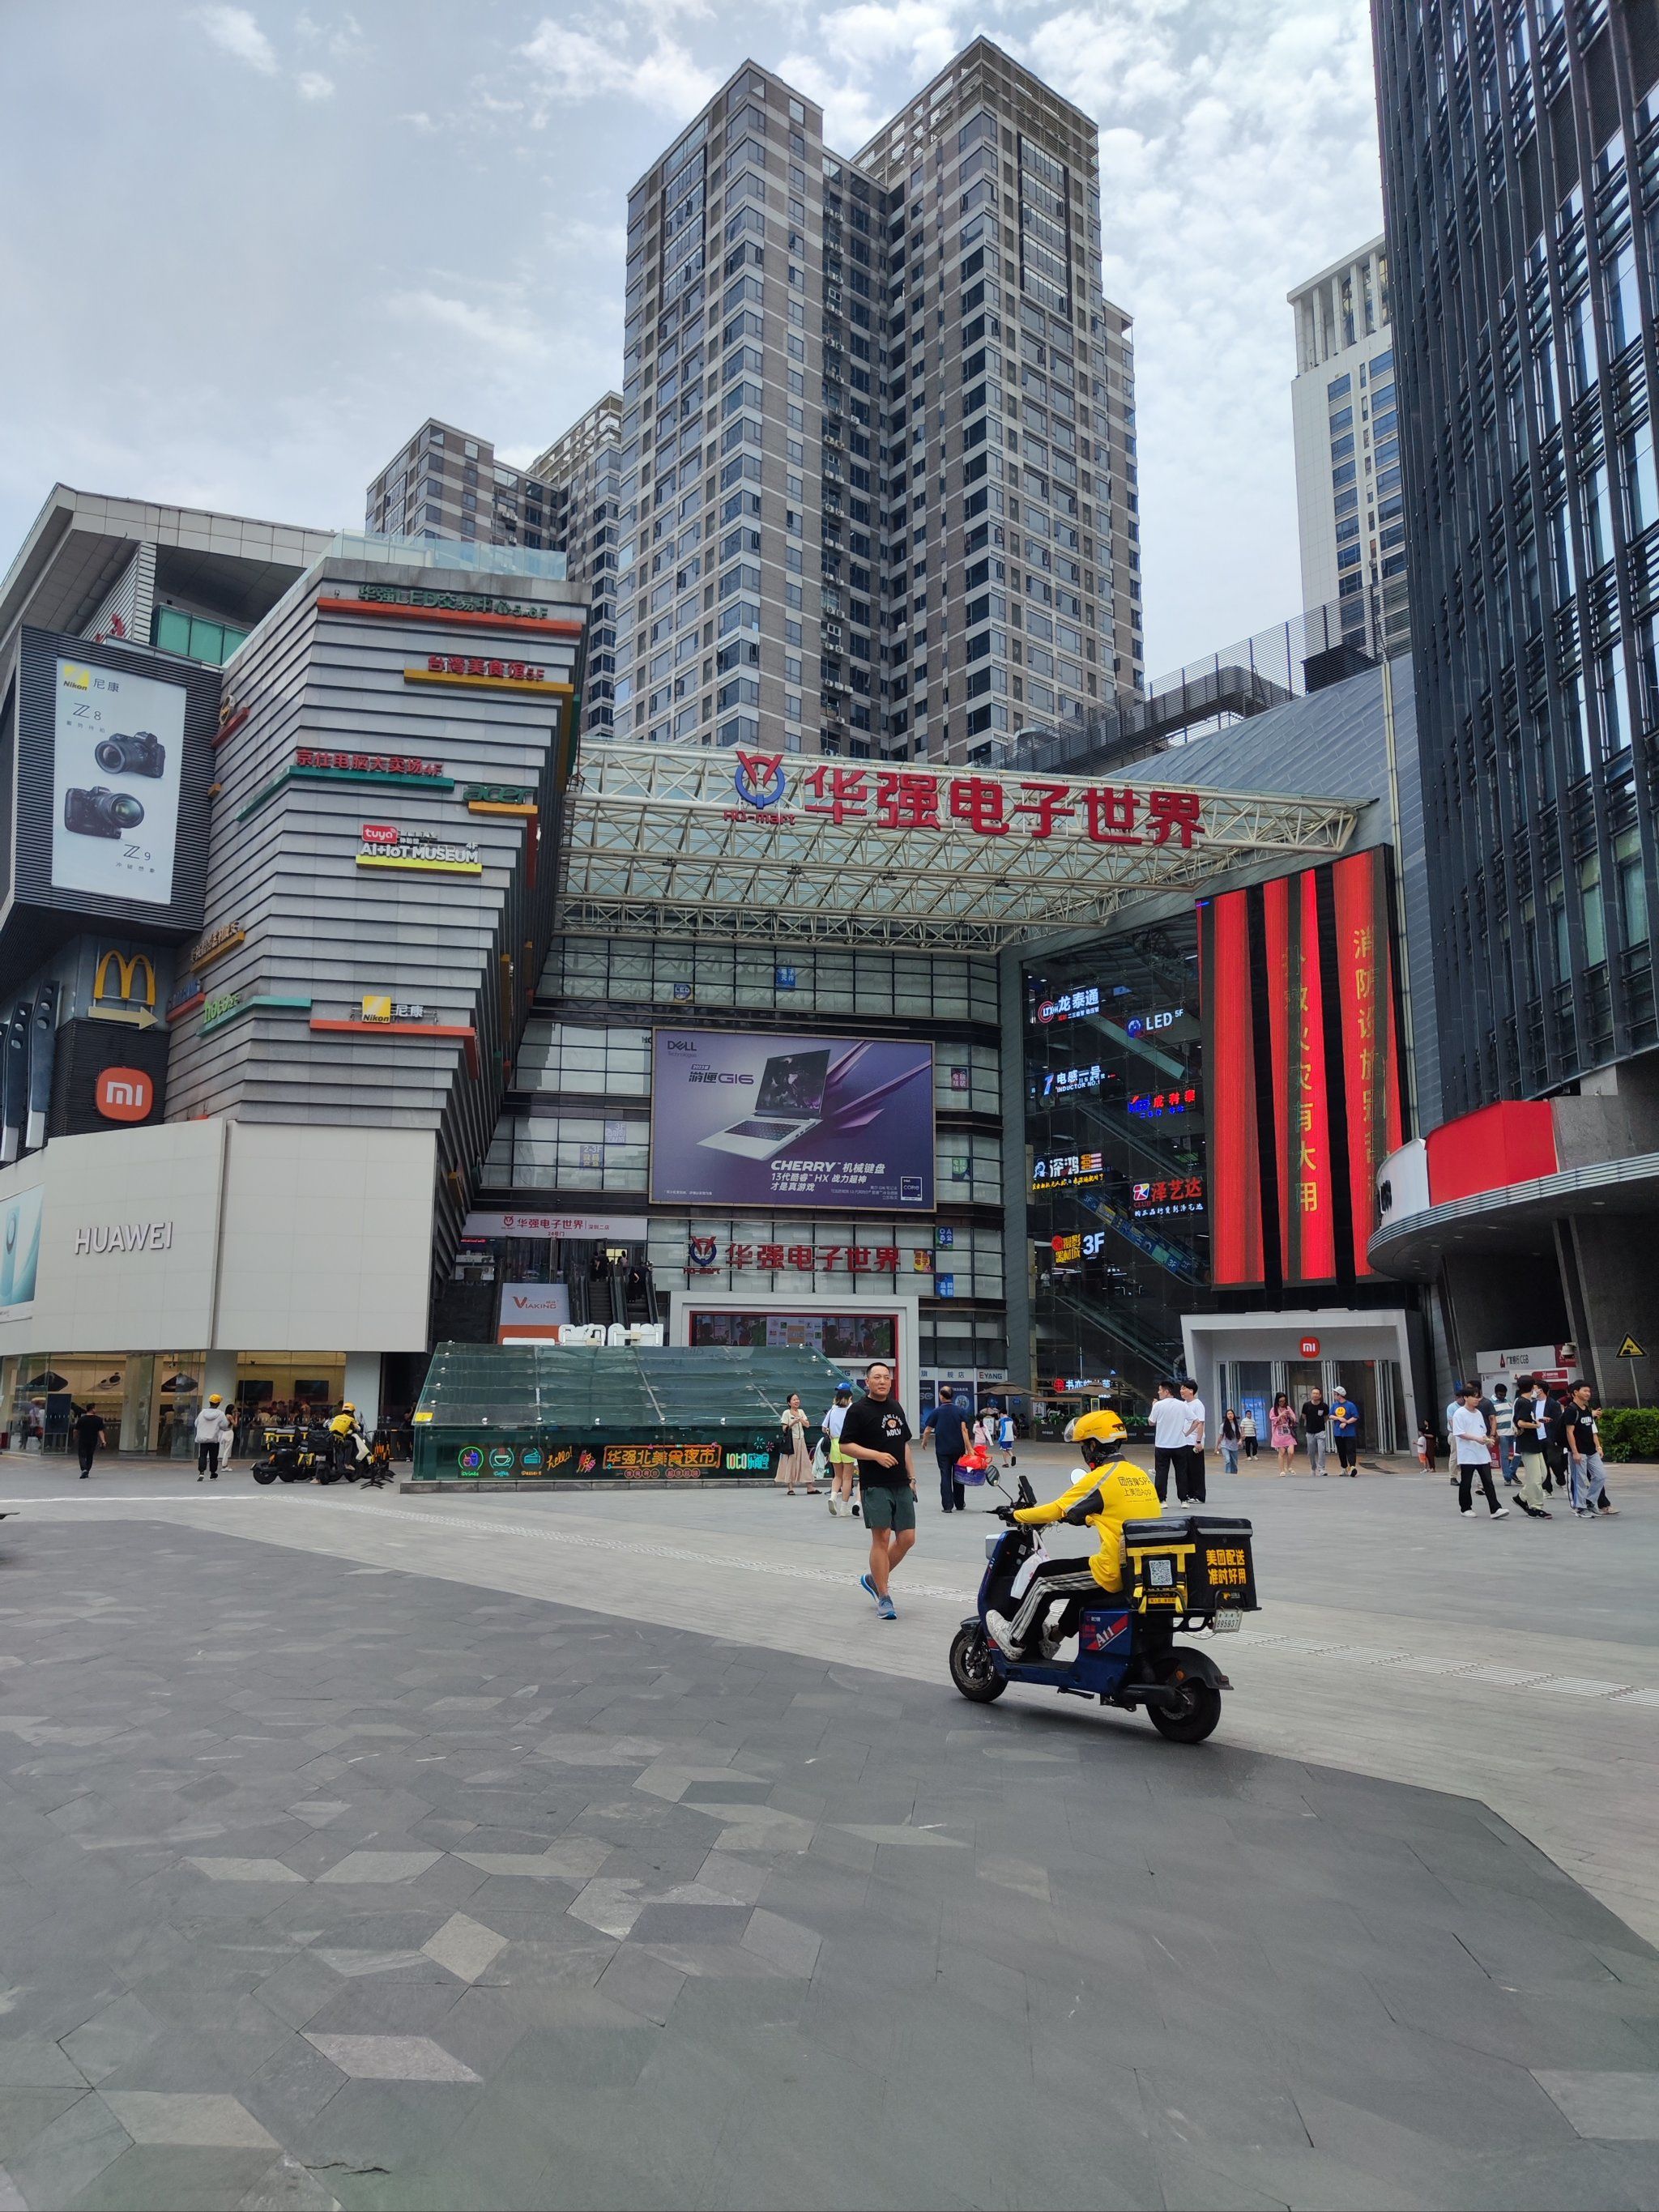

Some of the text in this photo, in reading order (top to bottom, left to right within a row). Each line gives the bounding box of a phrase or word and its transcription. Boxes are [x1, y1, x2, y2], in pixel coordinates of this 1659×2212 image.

[63, 678, 120, 693] Nikon 尼康
[94, 711, 101, 721] 8
[463, 783, 535, 805] acer
[804, 765, 1205, 849] 华强电子世界
[365, 827, 394, 841] tuya
[412, 846, 479, 863] MUSEUM
[466, 842, 479, 850] 4F
[144, 851, 151, 861] 9
[1058, 987, 1099, 1012] 龙泰通
[363, 1004, 424, 1023] Nikon 尼康
[1145, 1009, 1184, 1030] LED 5F
[667, 1040, 697, 1051] DELL
[1056, 1065, 1101, 1085] 电感一号
[1056, 1082, 1085, 1093] INDUCTOR
[583, 1145, 603, 1153] 2-3F
[842, 1163, 886, 1174] 机械键盘
[770, 1182, 815, 1191] 才是真游戏
[814, 1174, 829, 1183] HX
[1151, 1177, 1203, 1202] 泽艺达
[517, 1218, 583, 1230] 华强电子世界
[75, 1221, 173, 1255] HUAWEI
[1083, 1232, 1105, 1255] 3F
[725, 1242, 901, 1272] 华强电子世界
[979, 1371, 1003, 1379] EYANG
[547, 1446, 573, 1471] hello!
[607, 1448, 716, 1465] 华强北美食夜市
[1205, 1549, 1246, 1566] 美团配送
[1208, 1568, 1247, 1585] 准时好用
